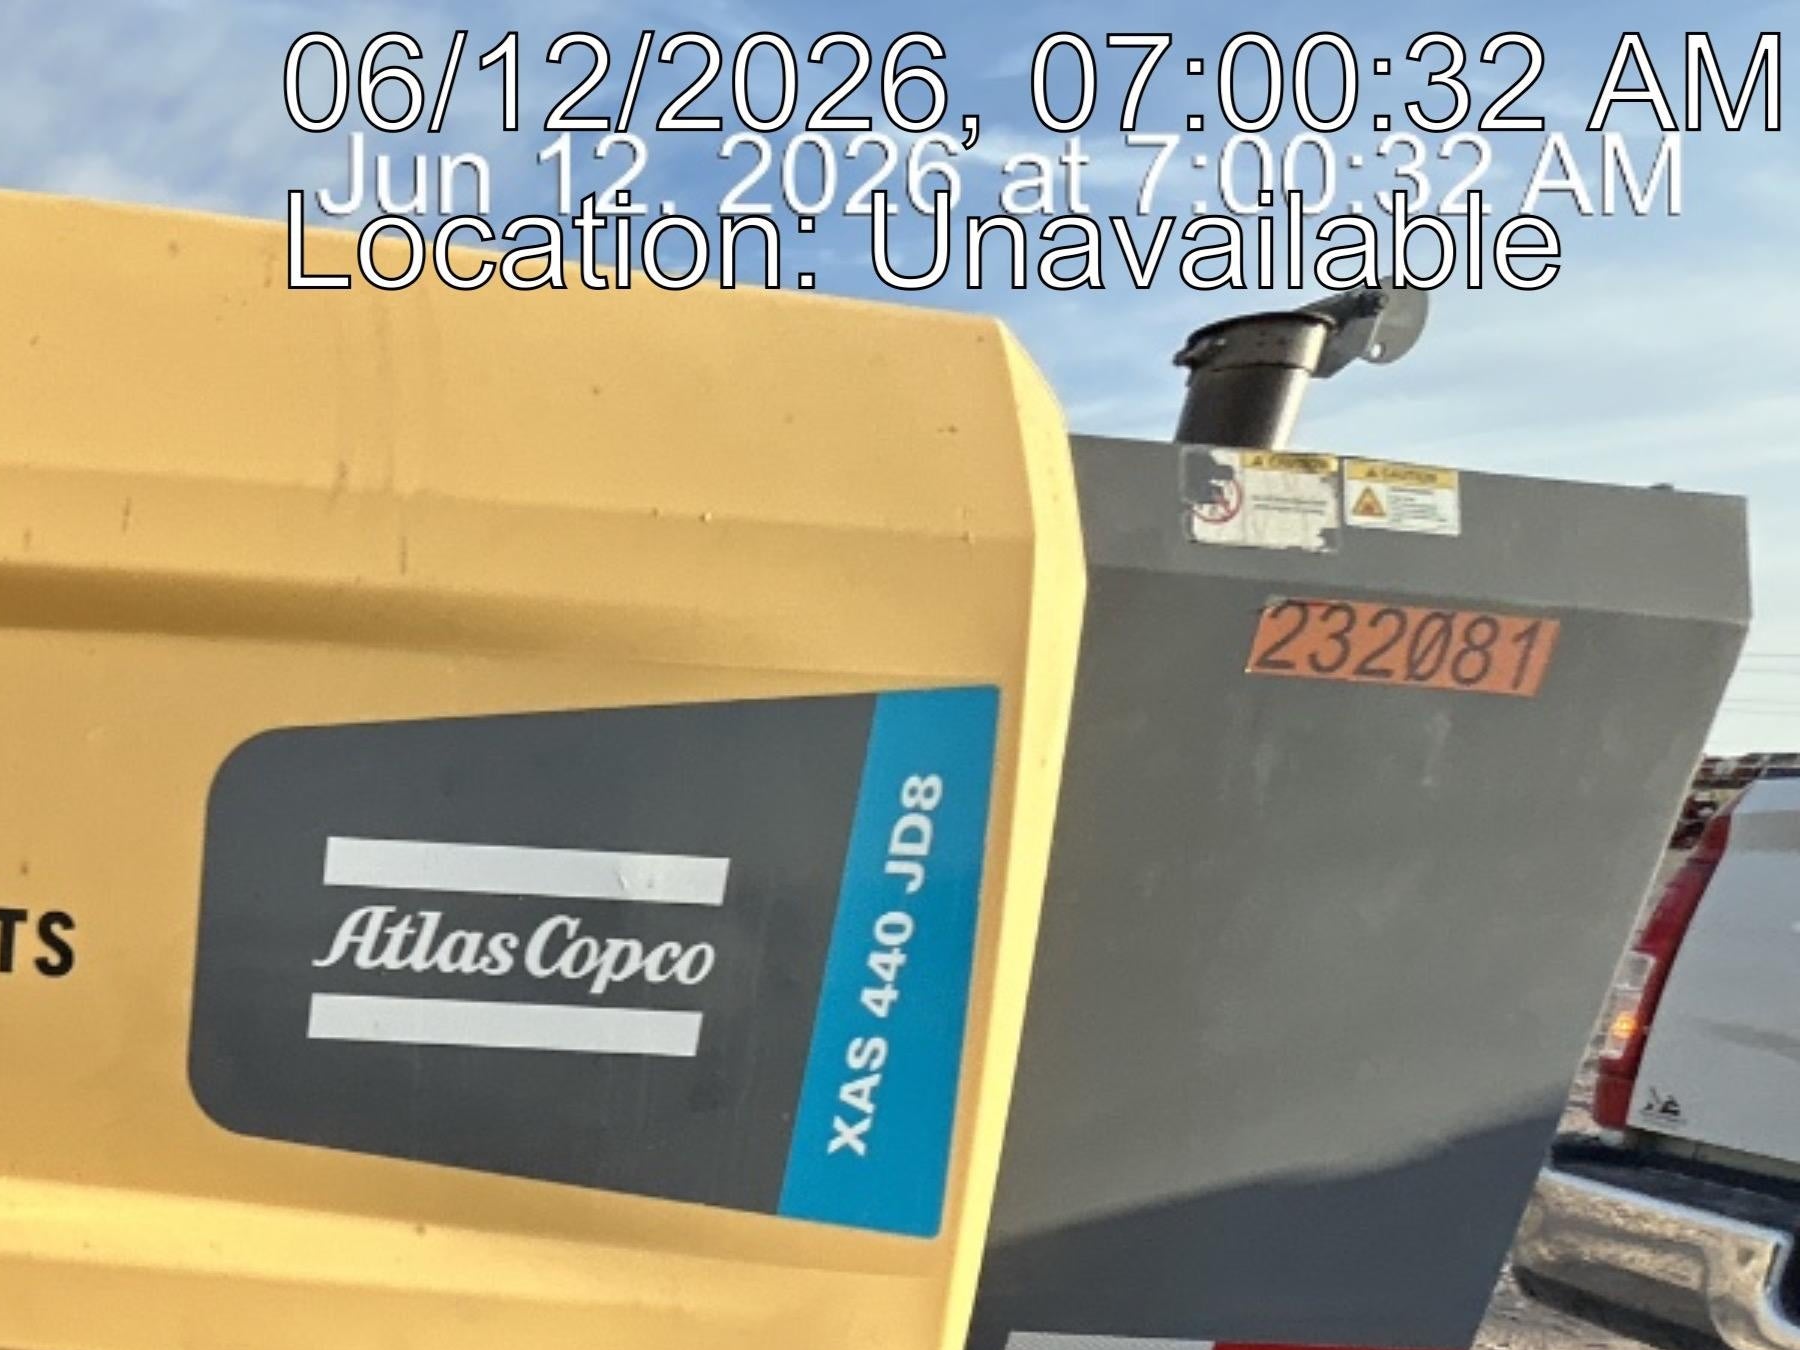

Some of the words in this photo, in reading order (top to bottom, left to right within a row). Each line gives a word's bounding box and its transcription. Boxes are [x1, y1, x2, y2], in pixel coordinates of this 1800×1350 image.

[1256, 601, 1541, 689] 232081
[885, 773, 943, 892] JD8
[312, 905, 518, 977] Atlas
[524, 914, 715, 993] Copco
[861, 911, 913, 1018] 440
[827, 1036, 887, 1156] XAS
